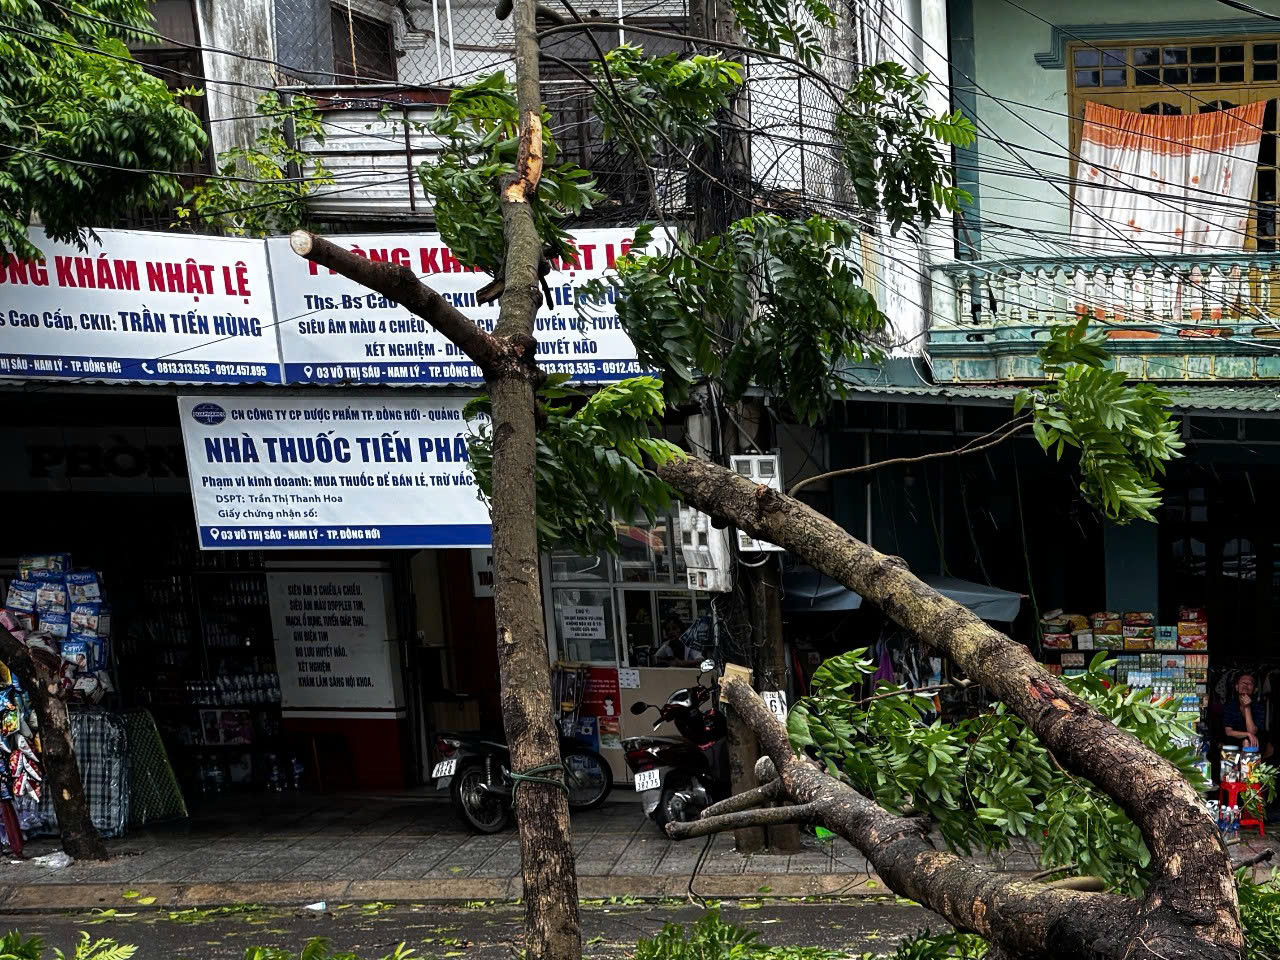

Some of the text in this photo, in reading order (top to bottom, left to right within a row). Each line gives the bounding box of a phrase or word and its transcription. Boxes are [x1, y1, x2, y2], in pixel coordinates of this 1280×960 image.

[54, 253, 251, 304] KHÁM NHẬT LỆ
[304, 295, 338, 310] Ths.
[342, 295, 363, 309] Bs
[9, 310, 40, 328] Cao
[43, 308, 77, 331] Cấp,
[118, 304, 166, 333] TRẦN
[170, 309, 210, 335] TIẾN
[213, 313, 262, 337] HÙNG
[299, 313, 566, 334] SIÊU ÂM MÀU 4 CHIỀU, UYẾN
[365, 342, 385, 357] XÉT
[388, 341, 435, 359] NGHIỆM
[573, 339, 598, 354] NÃO
[11, 357, 28, 370] SÁU
[34, 360, 53, 371] NAM
[54, 359, 63, 371] LÝ
[157, 362, 267, 376] 0813.313.535 0912.457.895
[316, 368, 328, 378] 03
[329, 366, 344, 378] VÕ
[346, 367, 360, 380] THỊ
[363, 366, 380, 378] SÁU
[387, 367, 408, 378] NAM
[410, 365, 420, 378] LÝ
[231, 409, 245, 420] CN
[247, 407, 273, 420] CÔNG
[275, 410, 286, 420] TY
[289, 410, 302, 420] CP
[333, 406, 360, 420] PHẨM
[377, 406, 402, 420] ĐỒNG
[404, 408, 420, 420] HỚI
[428, 407, 460, 421] QUẢNG
[204, 430, 470, 463] NHÀ THUỐC TIẾN PHÁ
[202, 476, 233, 490] Phạm
[235, 476, 245, 487] vi
[247, 476, 272, 487] kinh
[274, 476, 312, 487] doanh:
[314, 476, 337, 487] MUA
[339, 471, 374, 487] THUỐC
[392, 473, 413, 486] BÁN
[430, 472, 451, 486] TRỪ
[272, 494, 288, 505] Thị
[290, 494, 321, 503] Thanh
[324, 494, 343, 503] Hoa
[218, 508, 318, 519] Giấy chứng nhận số:
[221, 528, 380, 542] 03 VÕ THỊ SÁU NAM LÝ HỚI
